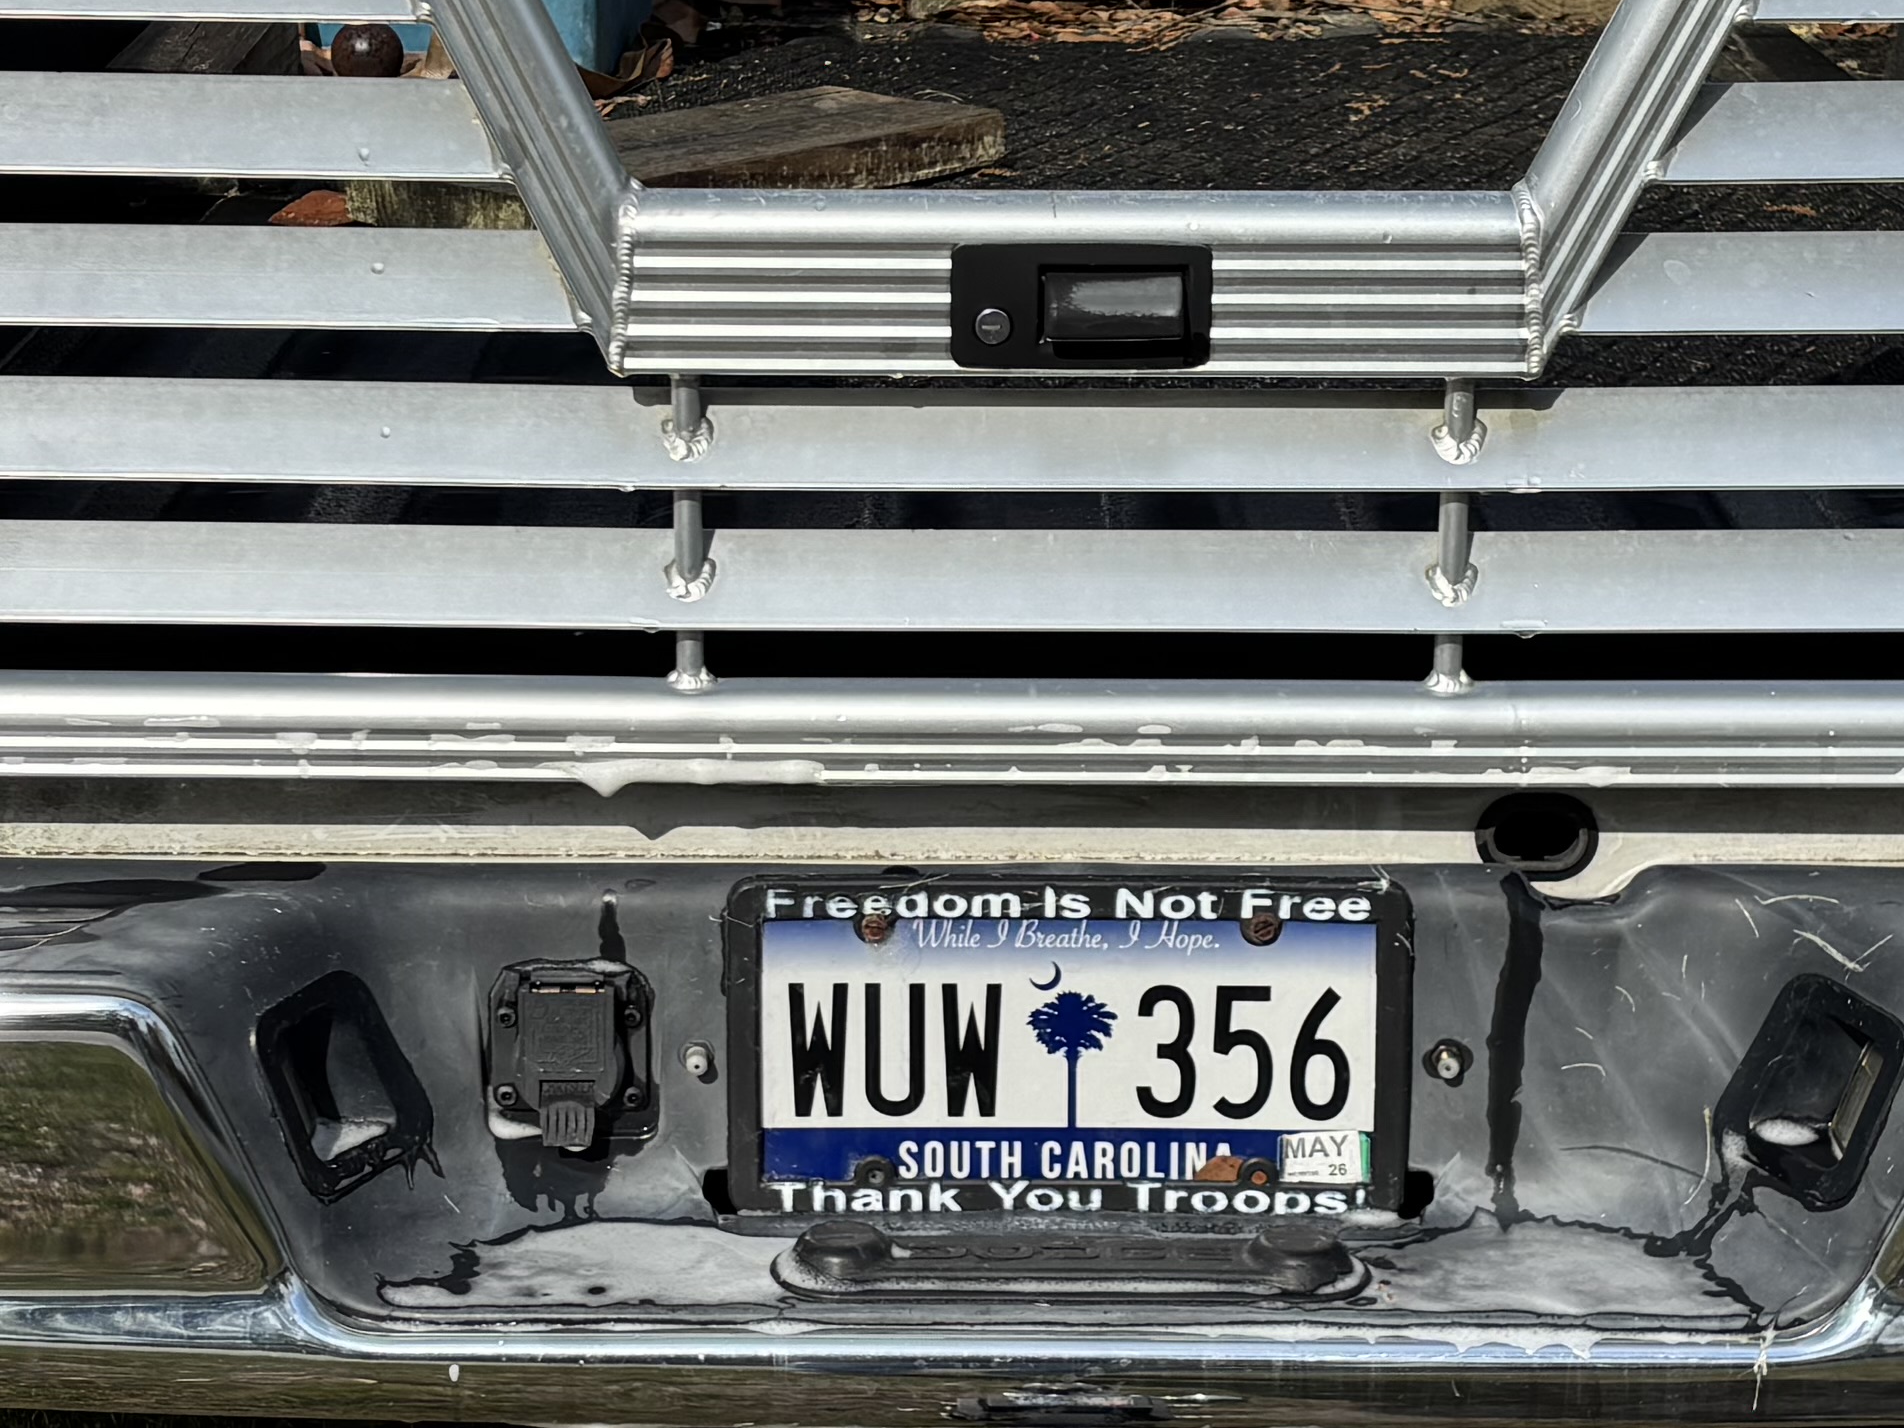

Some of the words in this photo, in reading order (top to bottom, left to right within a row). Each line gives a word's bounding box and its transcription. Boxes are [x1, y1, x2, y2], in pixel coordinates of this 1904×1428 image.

[764, 888, 1022, 919] Freedom
[1044, 886, 1092, 919] Is
[1115, 888, 1219, 920] Not
[1240, 889, 1372, 921] Free
[912, 920, 981, 949] While
[987, 920, 1009, 949] I
[1013, 920, 1109, 951] Breathe,
[1118, 920, 1142, 950] I
[1143, 920, 1220, 956] Hope.
[788, 982, 1003, 1118] WUW
[1135, 984, 1351, 1122] 356
[898, 1140, 1023, 1180] SOUTH
[1284, 1134, 1349, 1160] MAY
[1328, 1163, 1348, 1176] 26
[767, 1180, 964, 1213] Thank
[988, 1179, 1103, 1213] You
[1125, 1180, 1366, 1216] Troops!
